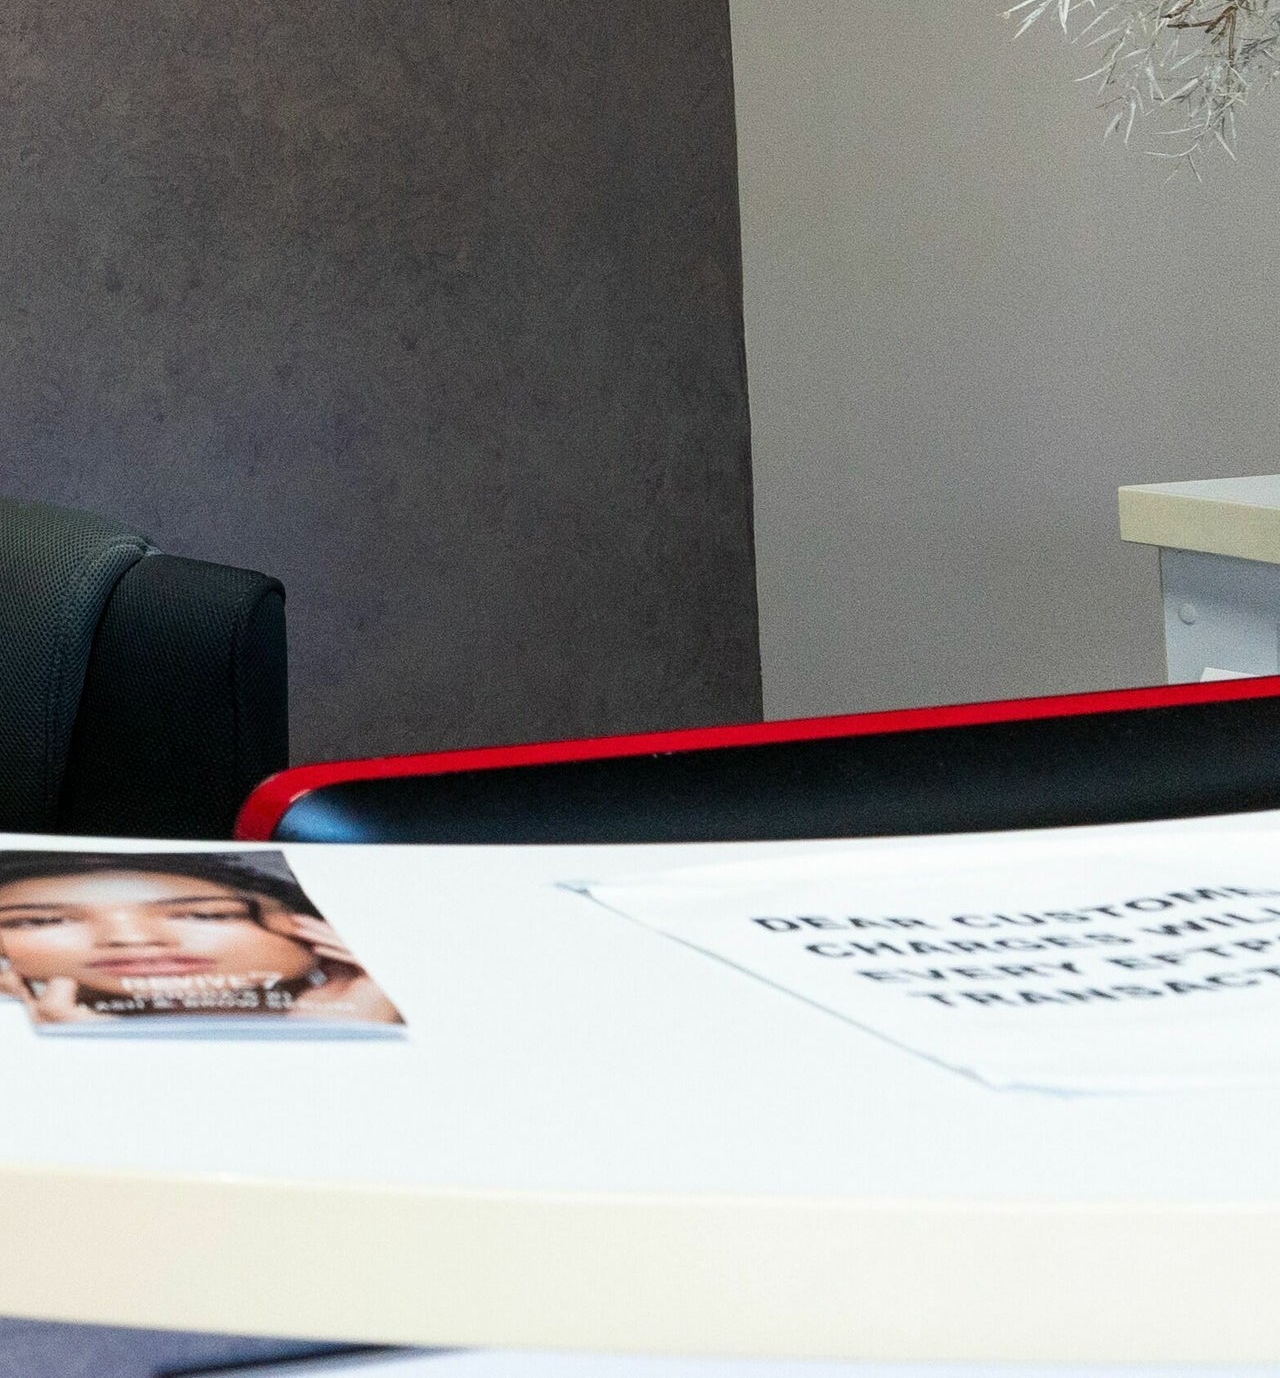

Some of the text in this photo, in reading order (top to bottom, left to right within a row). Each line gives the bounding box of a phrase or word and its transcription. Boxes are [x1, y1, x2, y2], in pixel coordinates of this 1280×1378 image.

[751, 915, 941, 933] DEAR
[803, 933, 1134, 959] CHARGES
[855, 962, 1086, 984] EVERY
